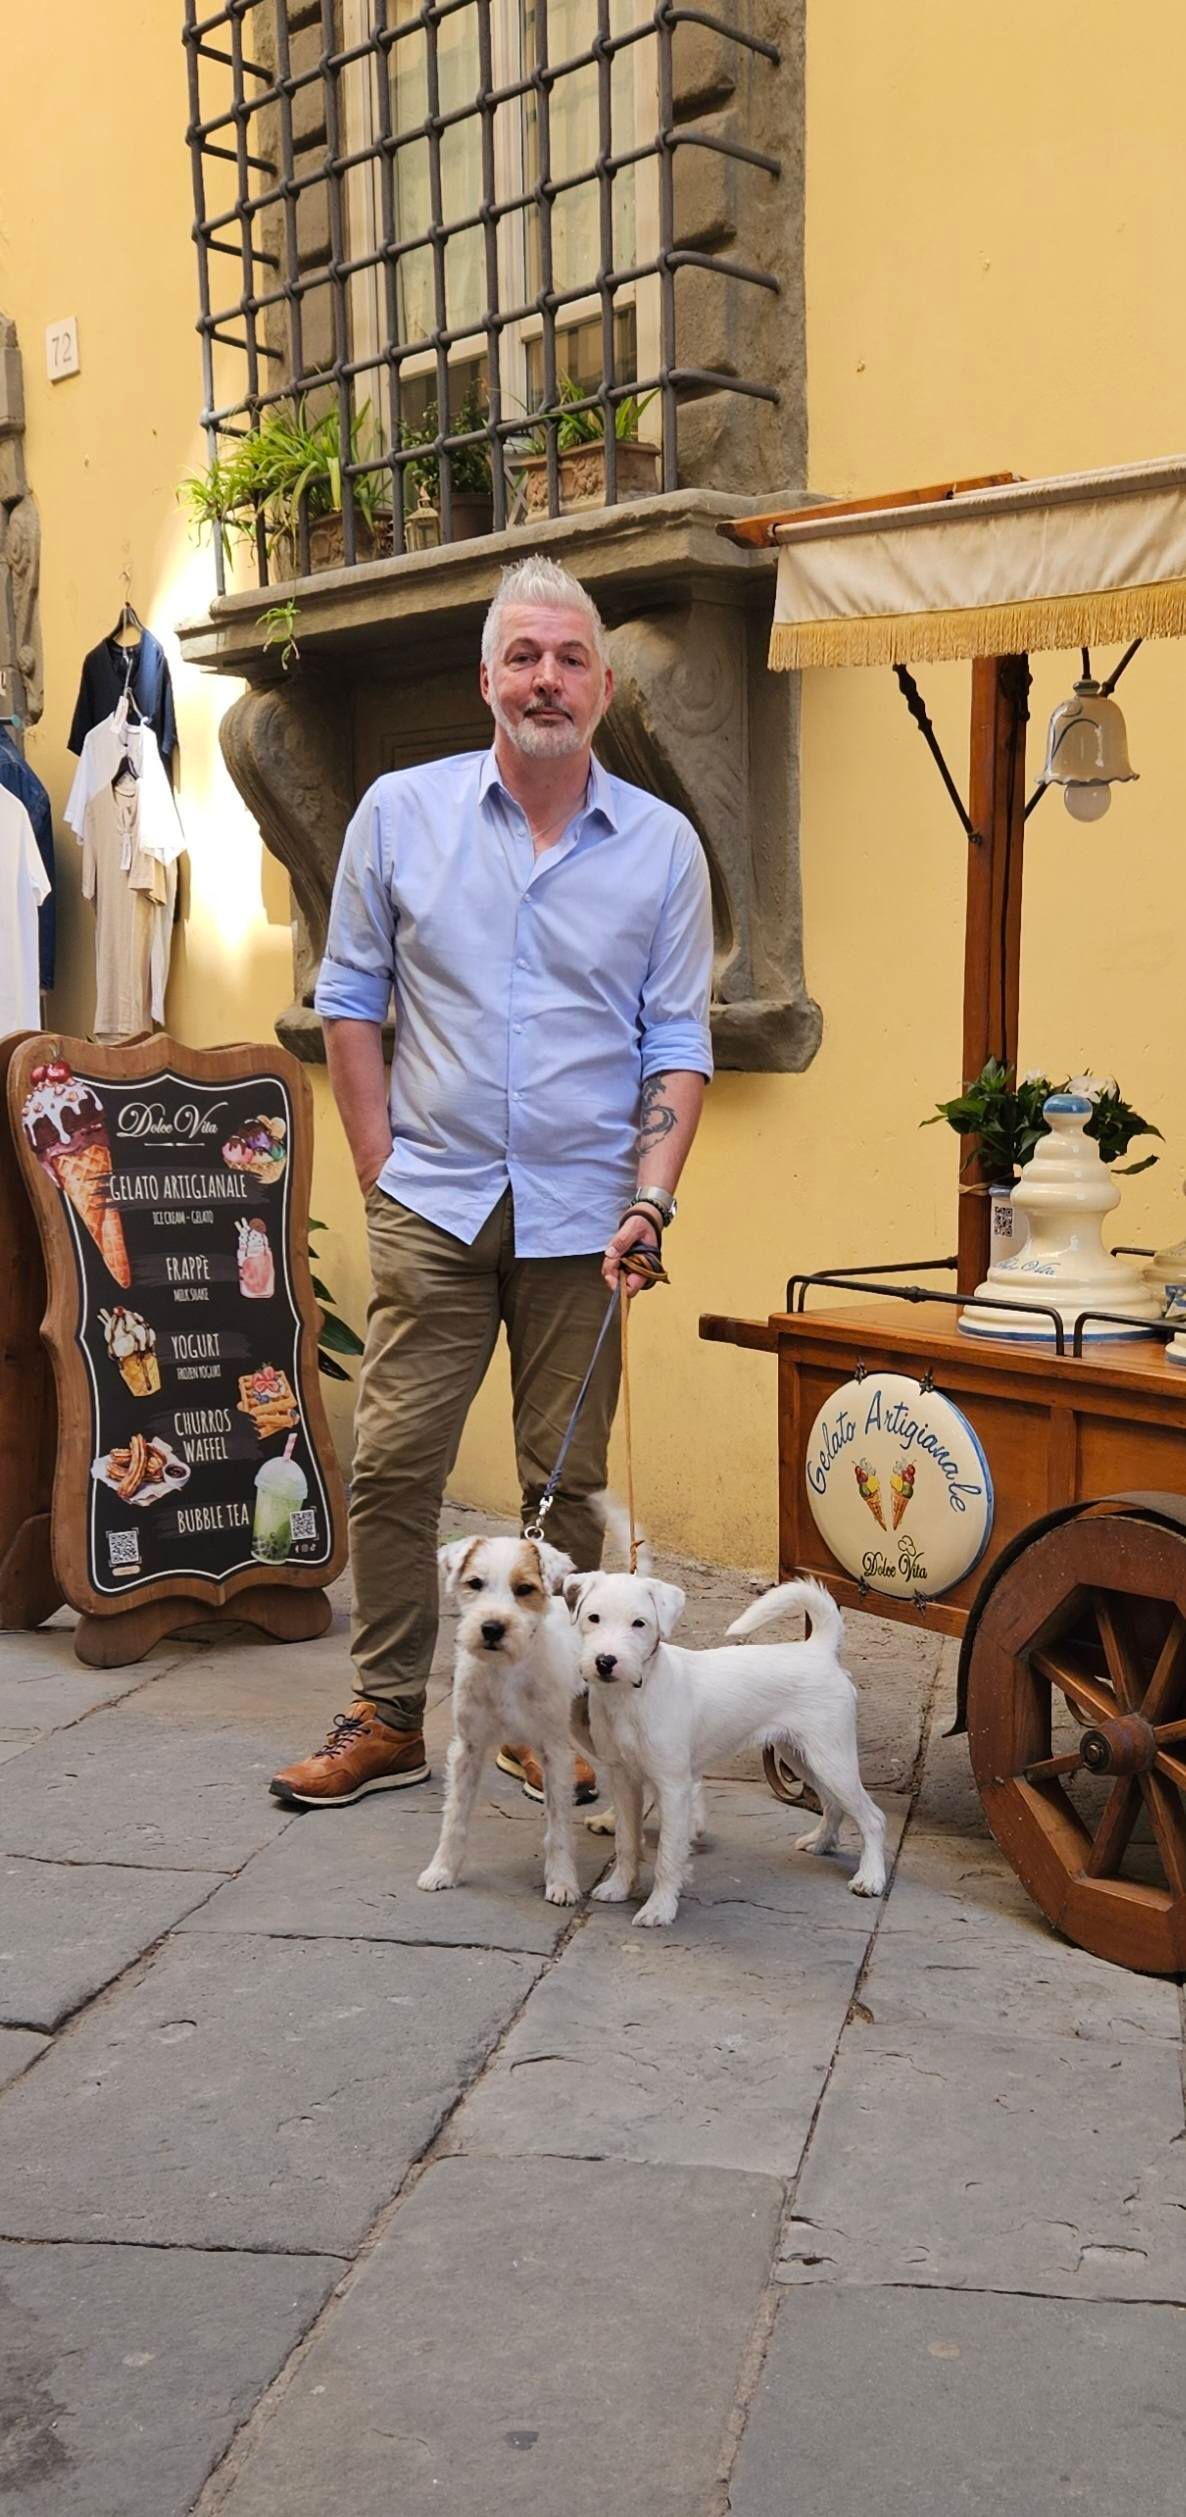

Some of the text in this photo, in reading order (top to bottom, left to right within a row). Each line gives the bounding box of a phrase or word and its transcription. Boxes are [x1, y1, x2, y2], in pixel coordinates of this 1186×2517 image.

[51, 331, 73, 368] 72
[116, 1101, 229, 1139] Dolce Vita
[109, 1174, 249, 1200] GELATO ARTIGIANALE
[165, 1254, 211, 1281] FRAPPÈ
[171, 1333, 220, 1360] YOGURT
[174, 1408, 232, 1436] CHURROS
[183, 1437, 229, 1463] WAFFEL
[807, 1390, 982, 1513] Gelato Artigianale
[177, 1502, 249, 1533] BUBBLE TEA
[862, 1551, 928, 1583] Dolce Vita
